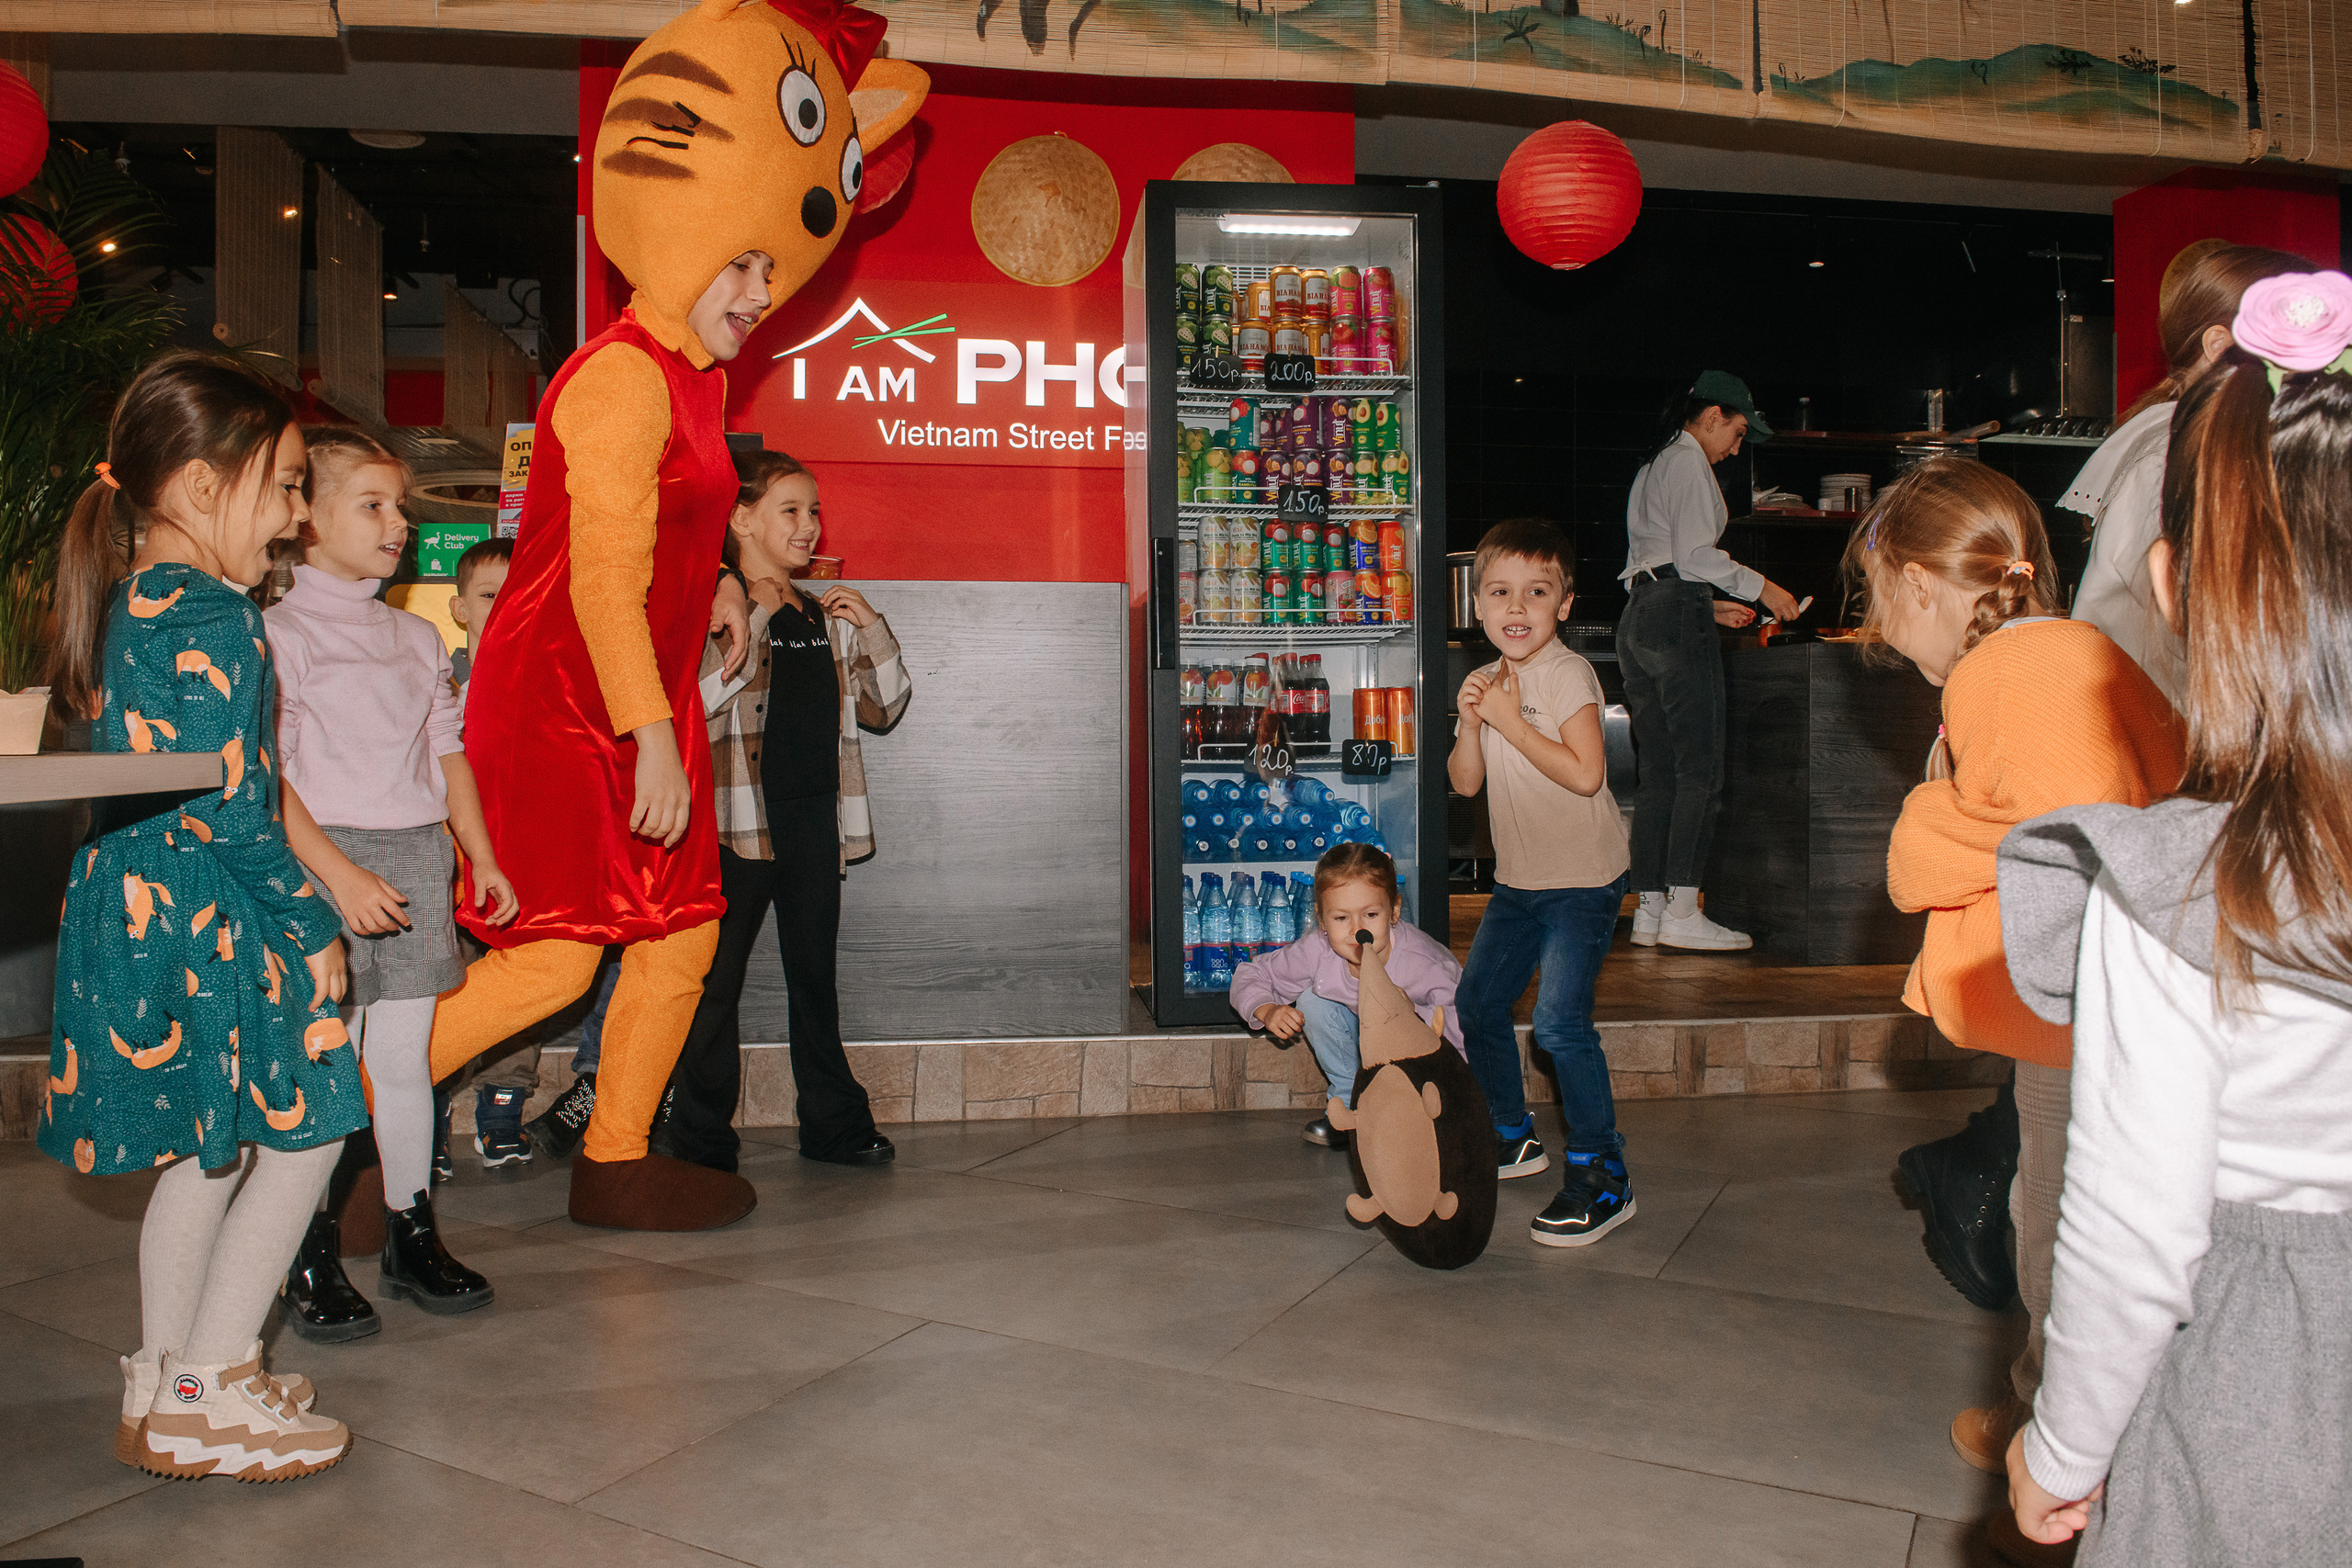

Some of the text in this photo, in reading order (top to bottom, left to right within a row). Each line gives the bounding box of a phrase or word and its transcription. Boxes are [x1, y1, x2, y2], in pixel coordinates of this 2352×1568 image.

[1204, 287, 1217, 313] Vinut
[1369, 288, 1382, 315] Vinut
[1376, 344, 1389, 369] Vnut
[793, 358, 806, 400] I
[836, 366, 915, 402] AM
[877, 419, 997, 448] Vietnam
[1008, 423, 1094, 450] Street
[1332, 419, 1346, 446] Vinut
[510, 441, 532, 451] ОП
[508, 469, 529, 478] ЗАК
[1204, 472, 1215, 496] Vnut
[444, 534, 479, 543] Delivery
[444, 541, 464, 549] Club
[1263, 540, 1272, 566] Vinut
[1349, 544, 1358, 568] Vinut
[1389, 544, 1401, 568] Vinut
[1383, 592, 1393, 618] Vnut
[769, 638, 784, 647] lah
[811, 637, 829, 647] blah
